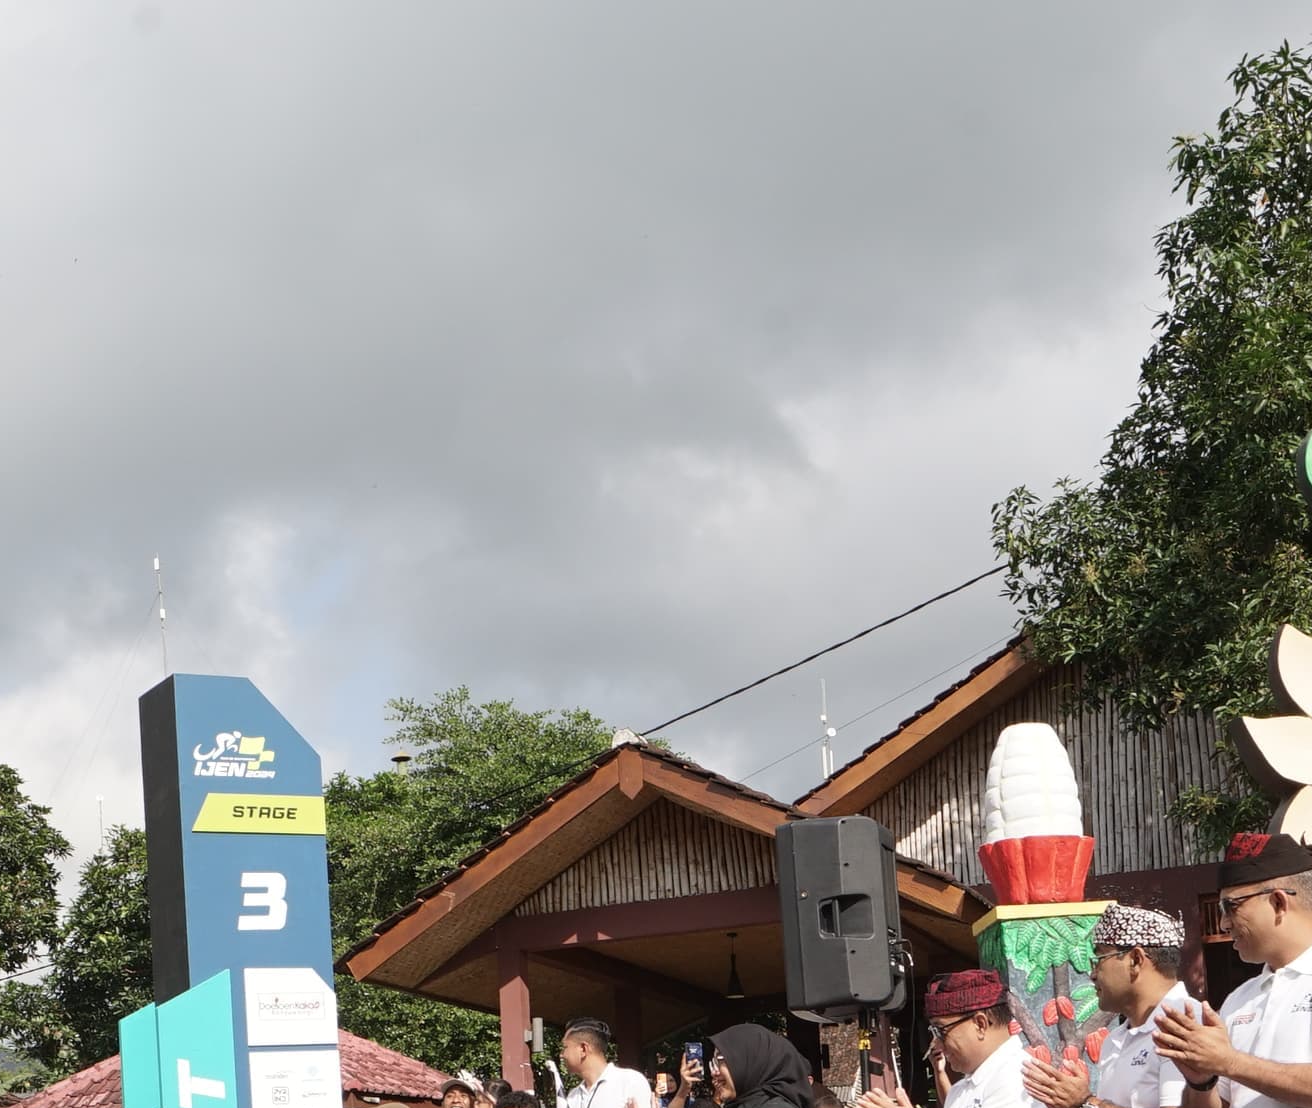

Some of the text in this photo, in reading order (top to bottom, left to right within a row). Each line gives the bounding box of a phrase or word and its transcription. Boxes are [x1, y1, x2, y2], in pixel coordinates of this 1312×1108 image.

[194, 761, 246, 777] IJEN
[232, 805, 298, 820] STAGE
[238, 872, 288, 931] 3
